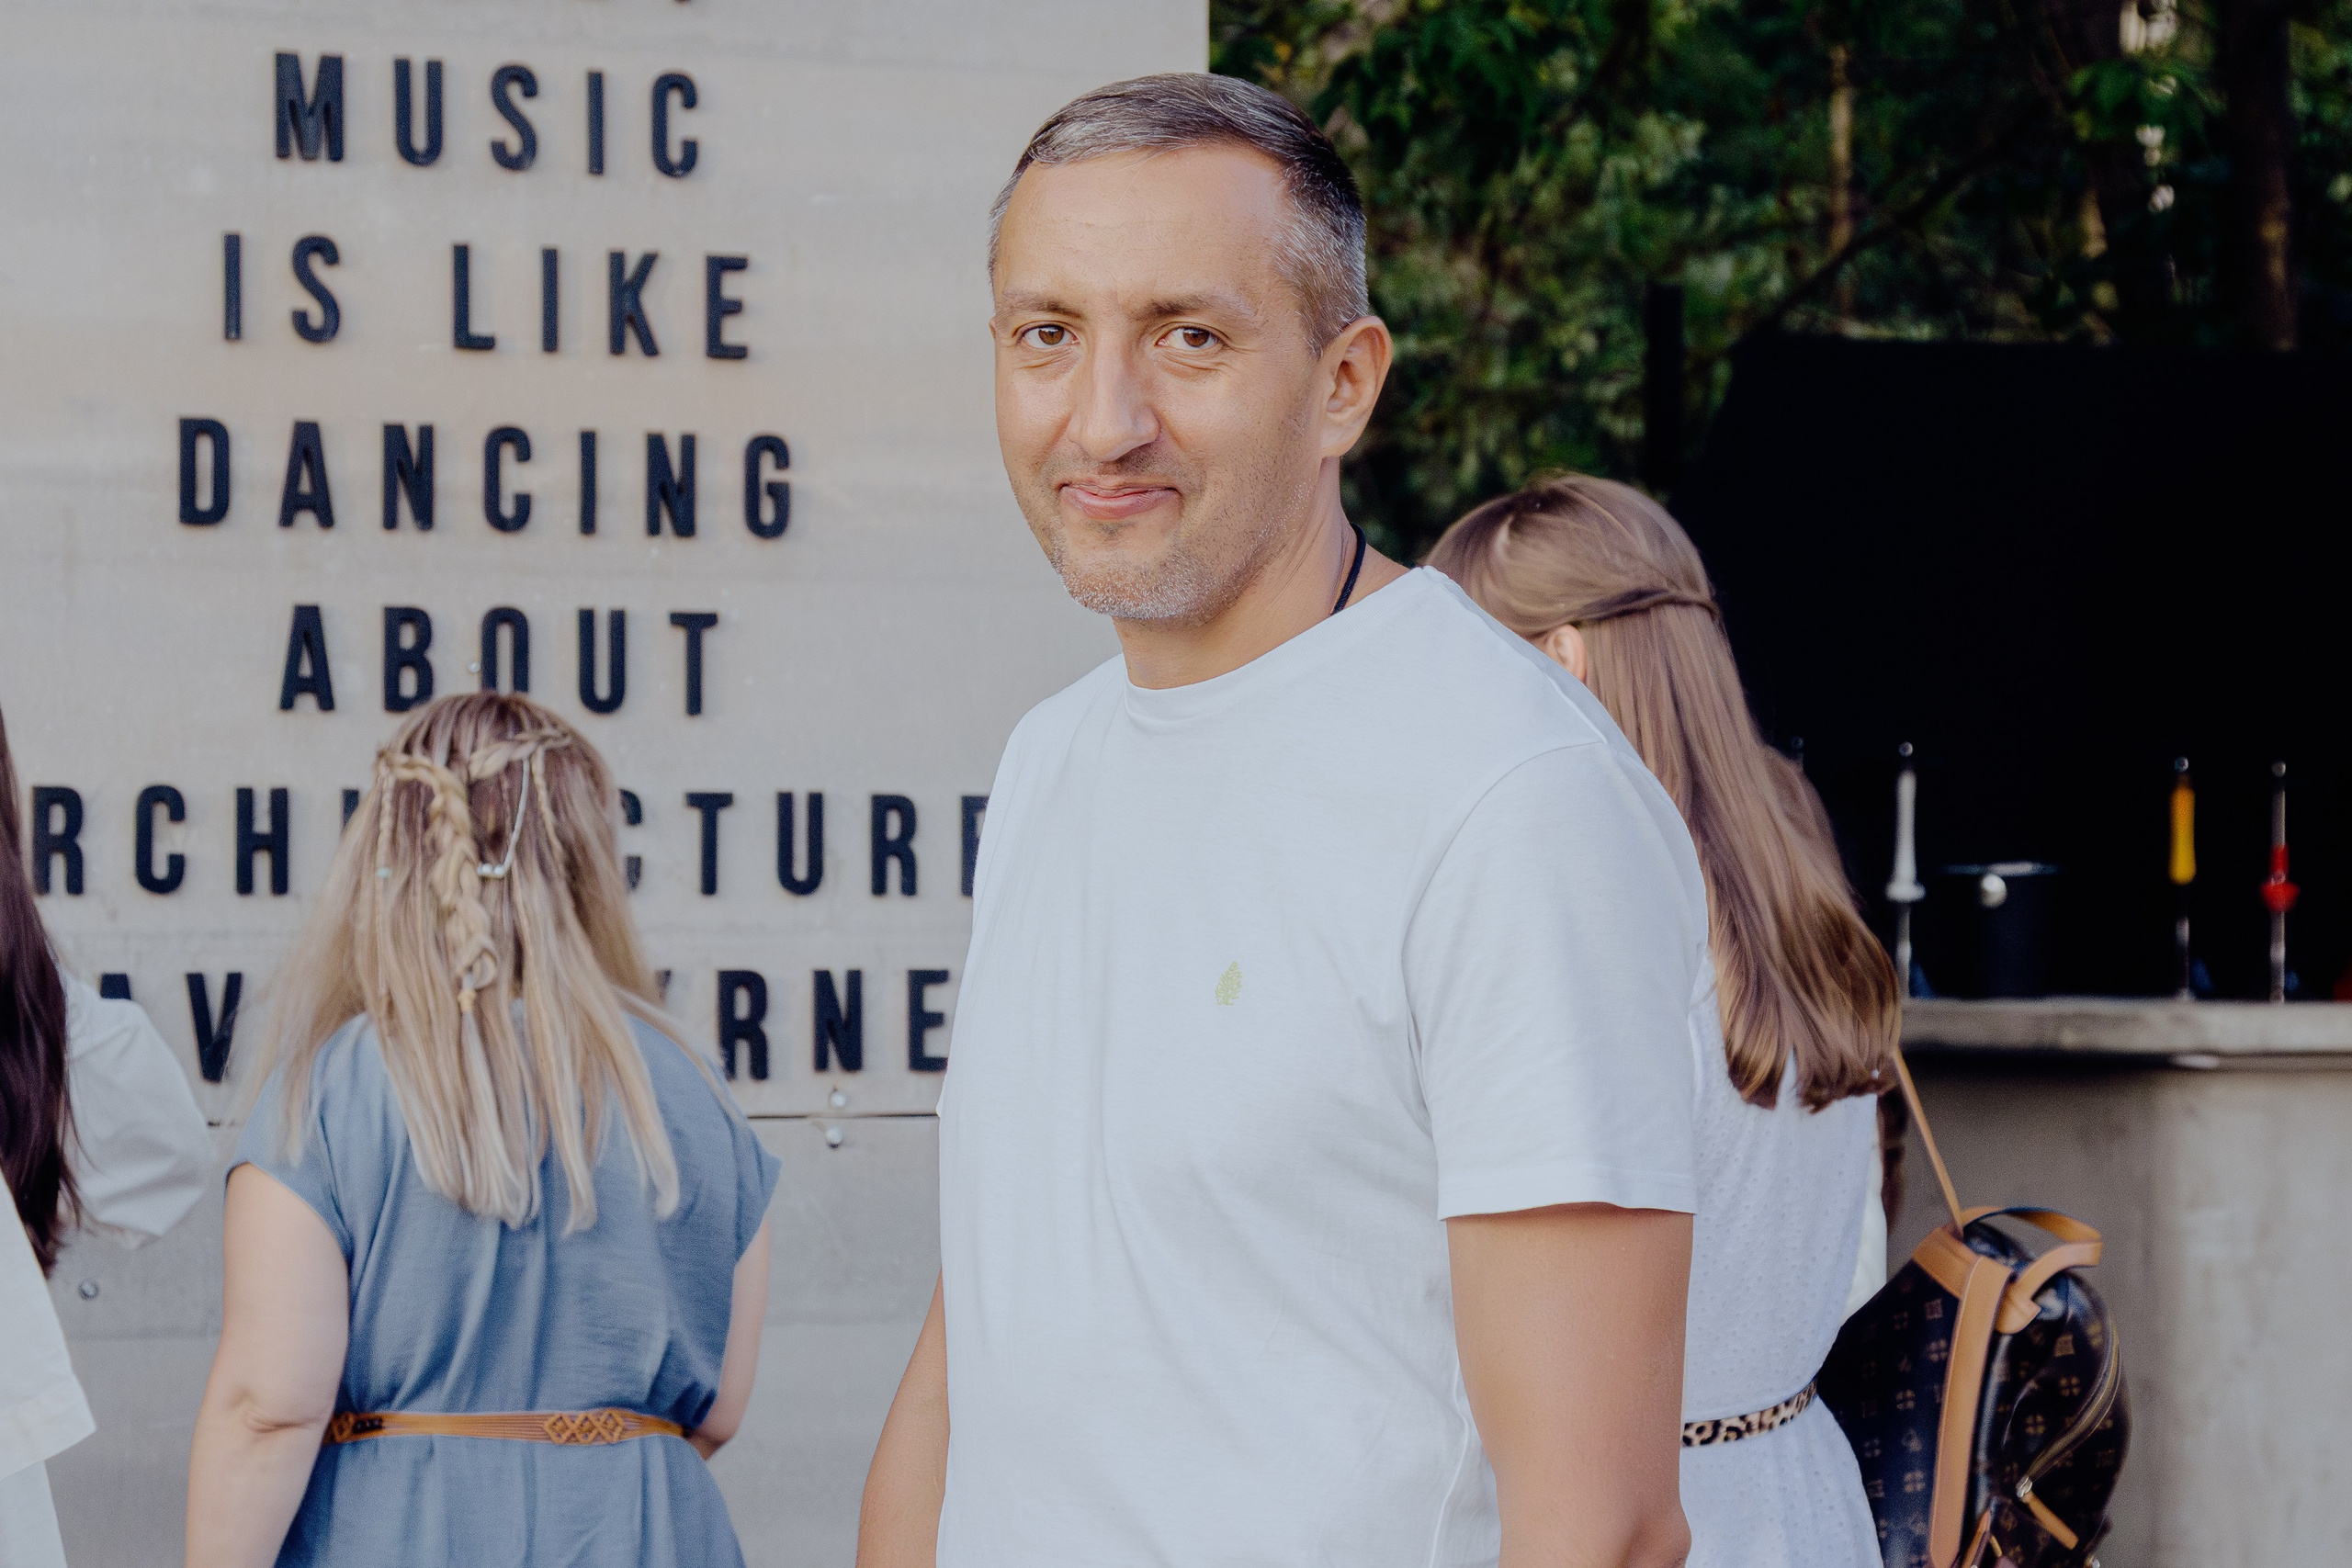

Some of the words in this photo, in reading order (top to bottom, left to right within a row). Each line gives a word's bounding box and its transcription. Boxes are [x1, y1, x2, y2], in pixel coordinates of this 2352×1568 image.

[274, 51, 699, 180] MUSIC
[223, 232, 342, 346] IS
[452, 243, 750, 363] LIKE
[177, 417, 792, 541] DANCING
[278, 604, 719, 718] ABOUT
[655, 968, 951, 1083] RNE
